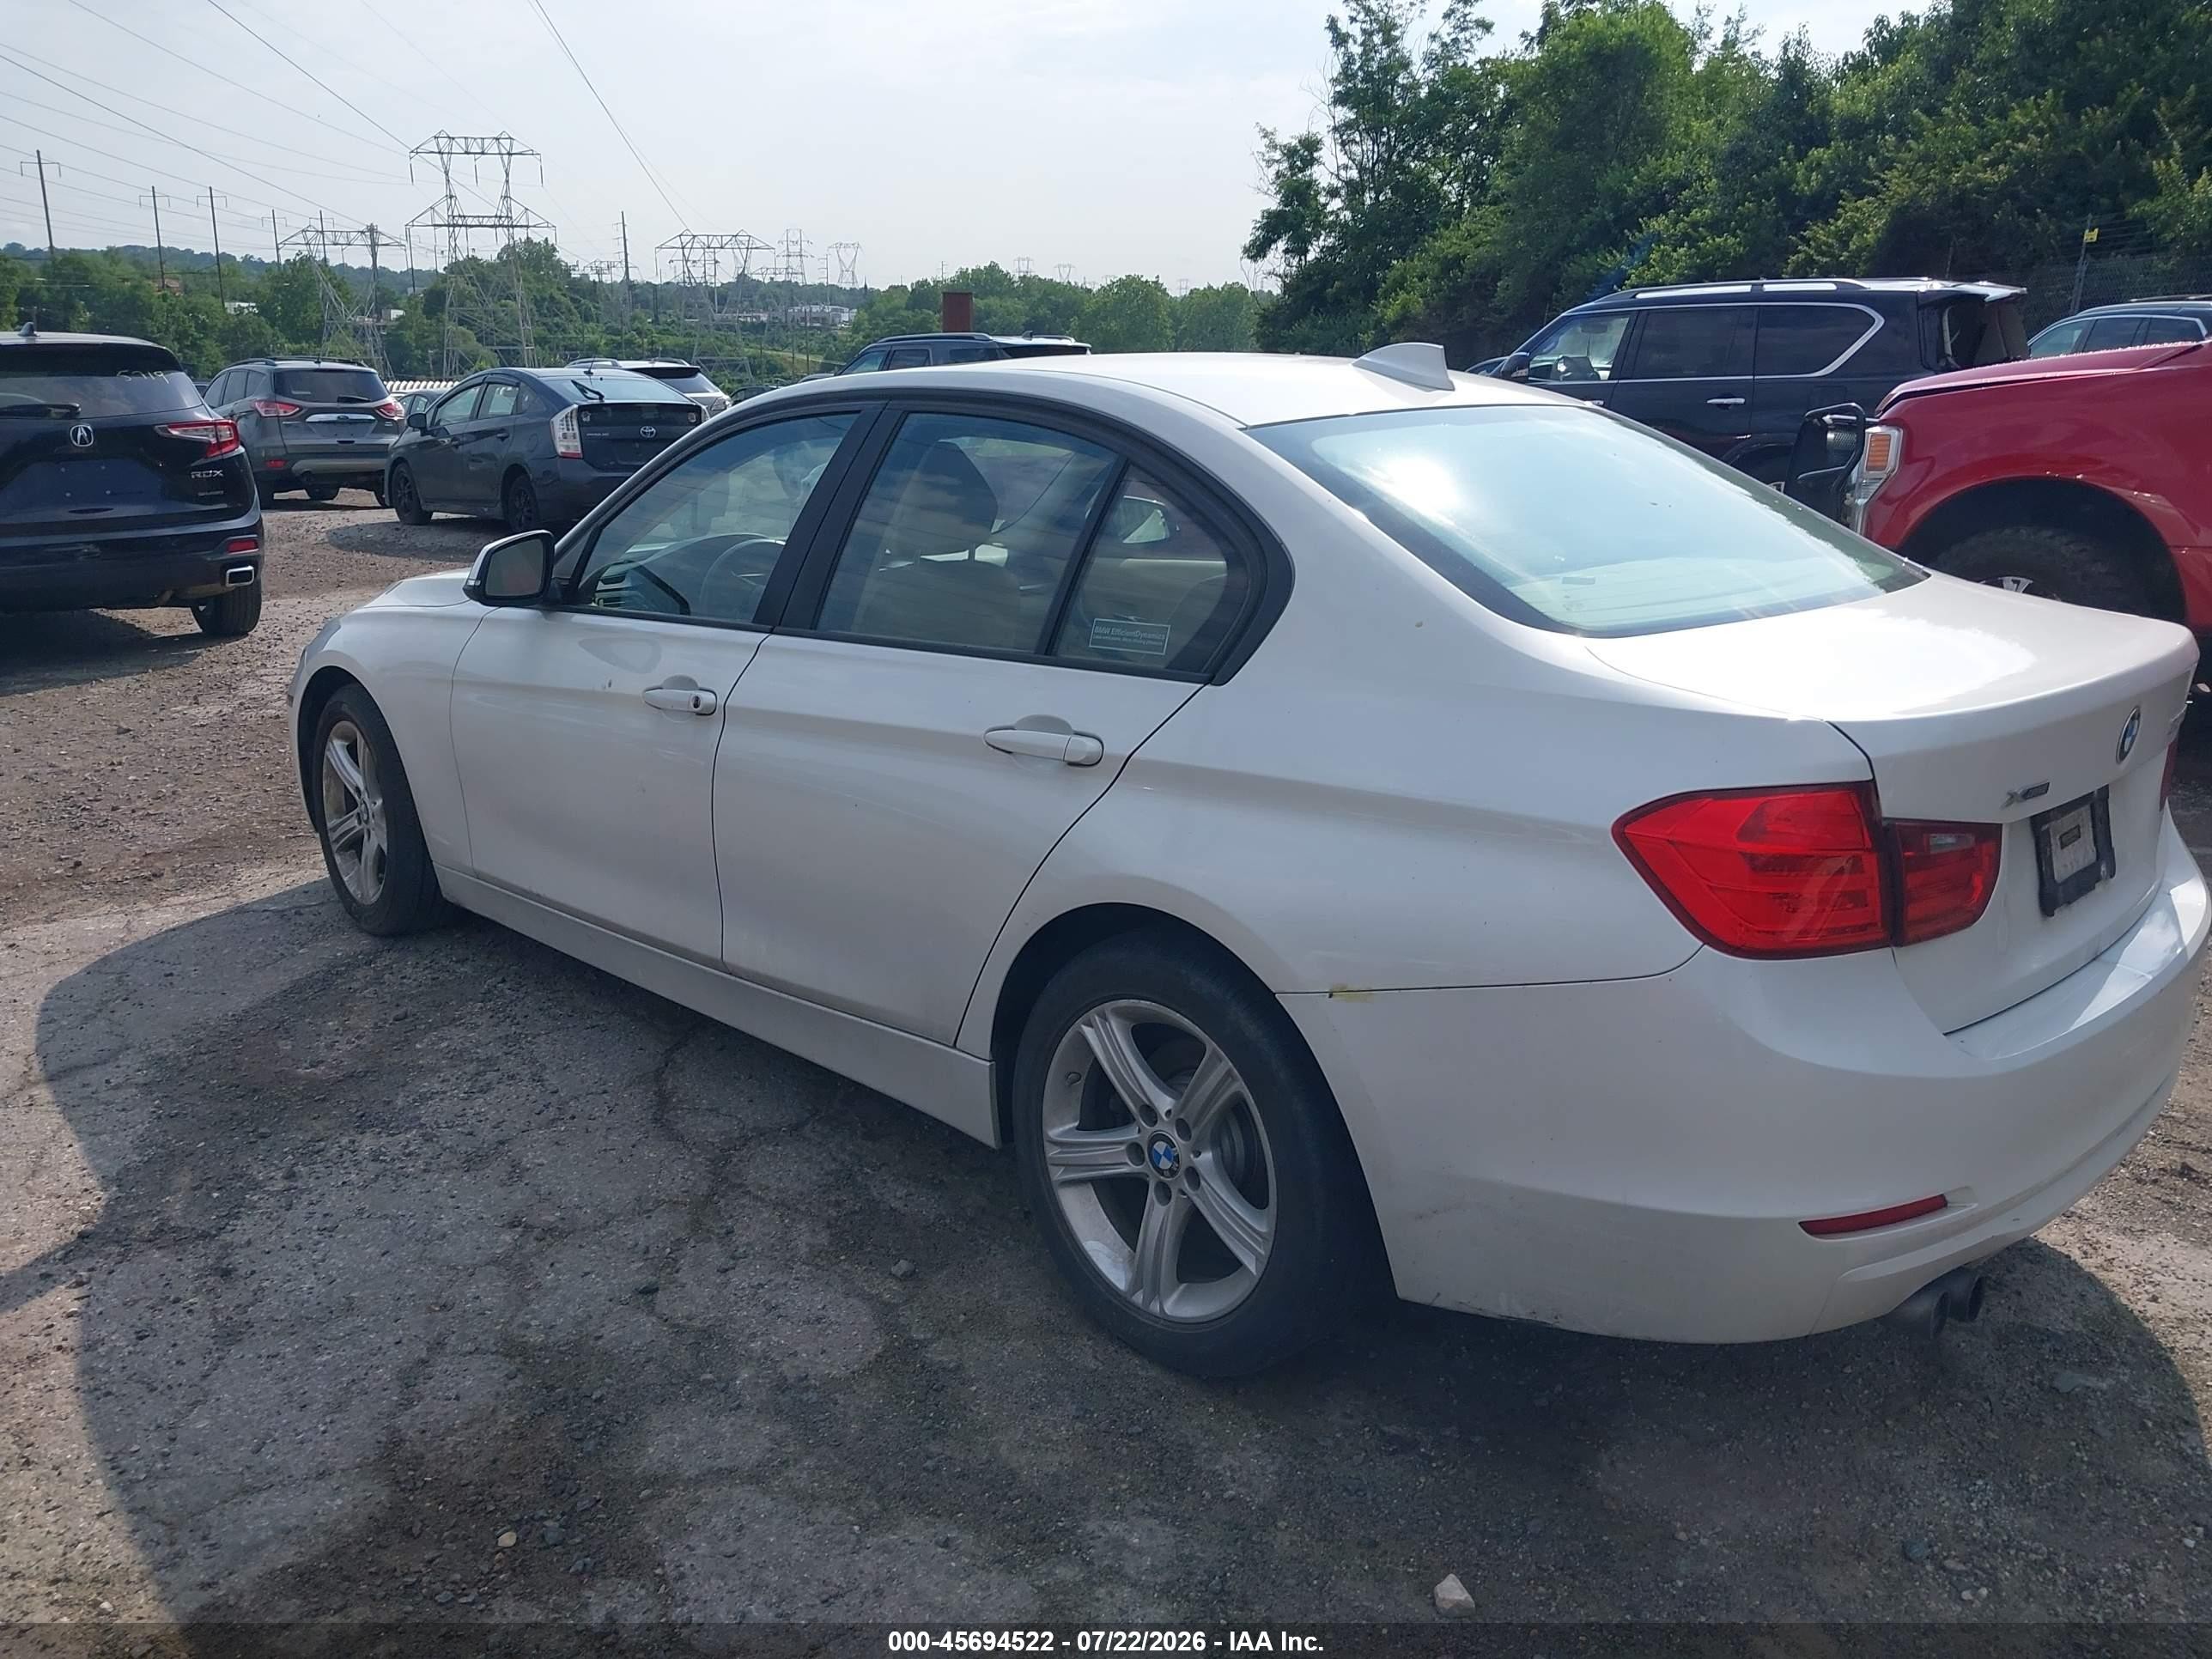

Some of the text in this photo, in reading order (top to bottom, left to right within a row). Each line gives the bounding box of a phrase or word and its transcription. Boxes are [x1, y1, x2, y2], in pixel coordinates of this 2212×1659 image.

[117, 370, 170, 384] 5719
[191, 470, 224, 478] RDX
[1094, 625, 1110, 635] BMW
